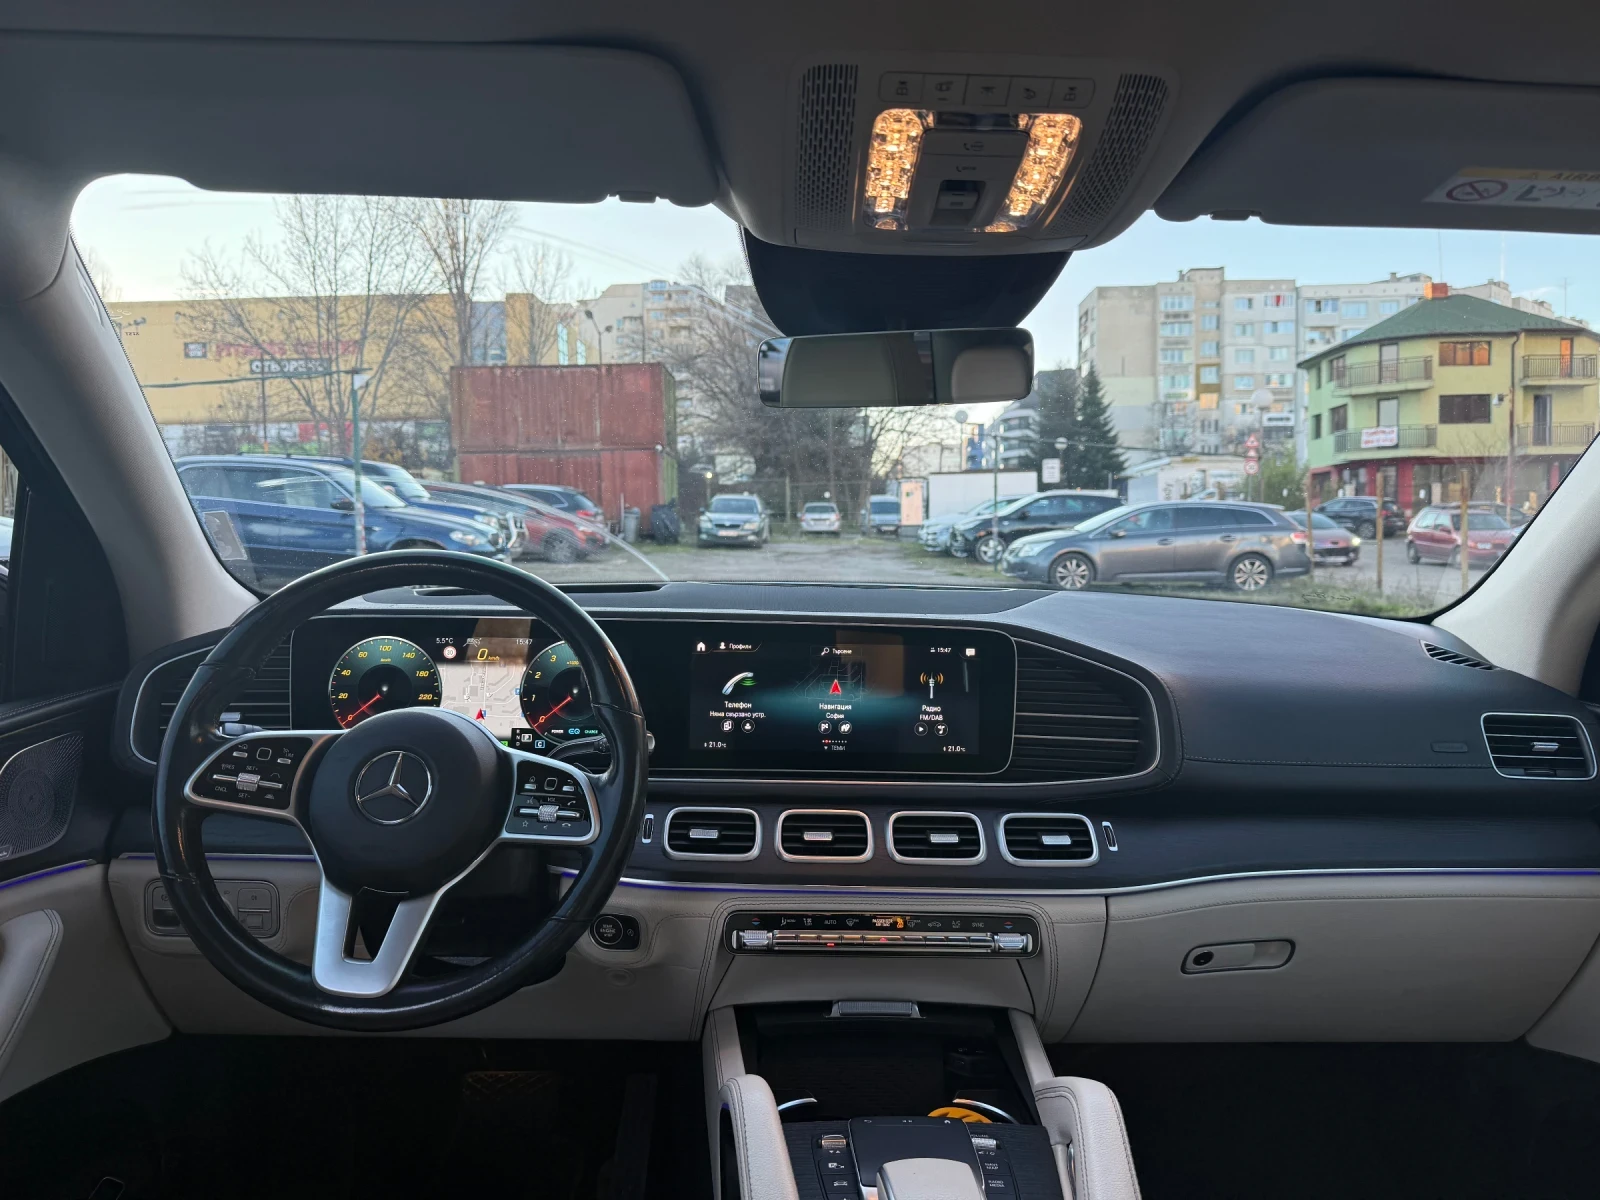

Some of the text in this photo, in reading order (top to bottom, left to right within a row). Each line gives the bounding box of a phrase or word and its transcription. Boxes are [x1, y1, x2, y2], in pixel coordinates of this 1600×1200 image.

[477, 648, 488, 660] 0
[535, 671, 541, 679] 2
[531, 694, 536, 702] 1
[724, 700, 752, 709] Телефон
[819, 702, 852, 711] Навигация
[921, 704, 941, 713] Радио
